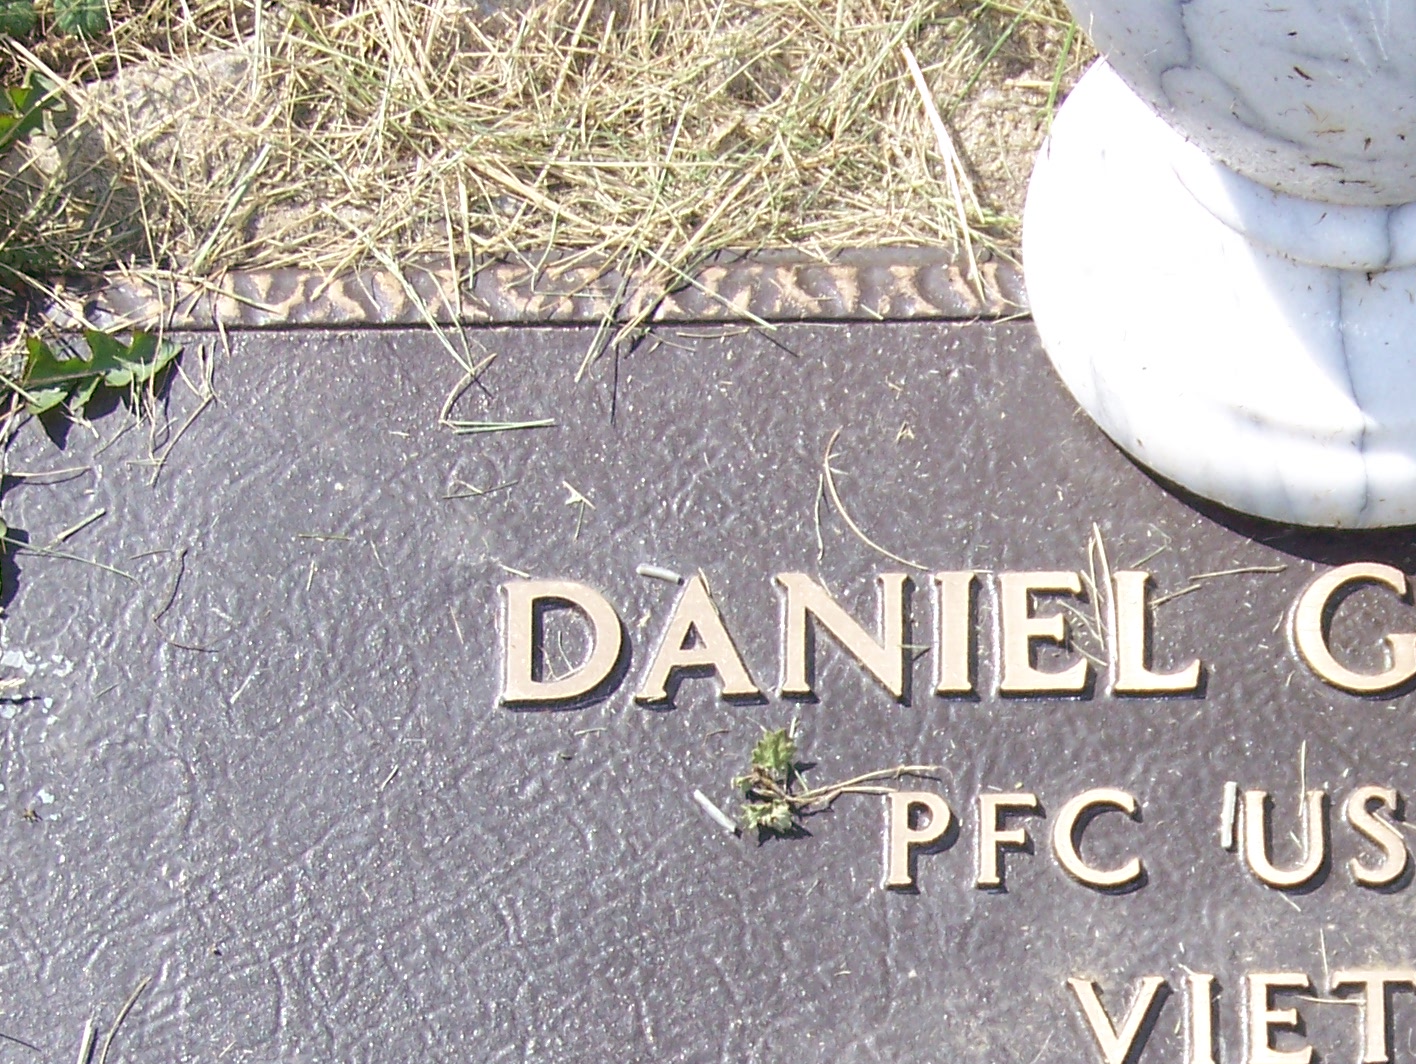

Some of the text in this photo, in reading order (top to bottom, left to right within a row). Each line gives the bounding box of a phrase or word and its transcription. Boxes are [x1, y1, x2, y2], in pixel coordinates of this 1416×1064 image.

[499, 569, 1202, 706] DANIEL
[883, 786, 1144, 889] PFC
[1242, 785, 1408, 889] US
